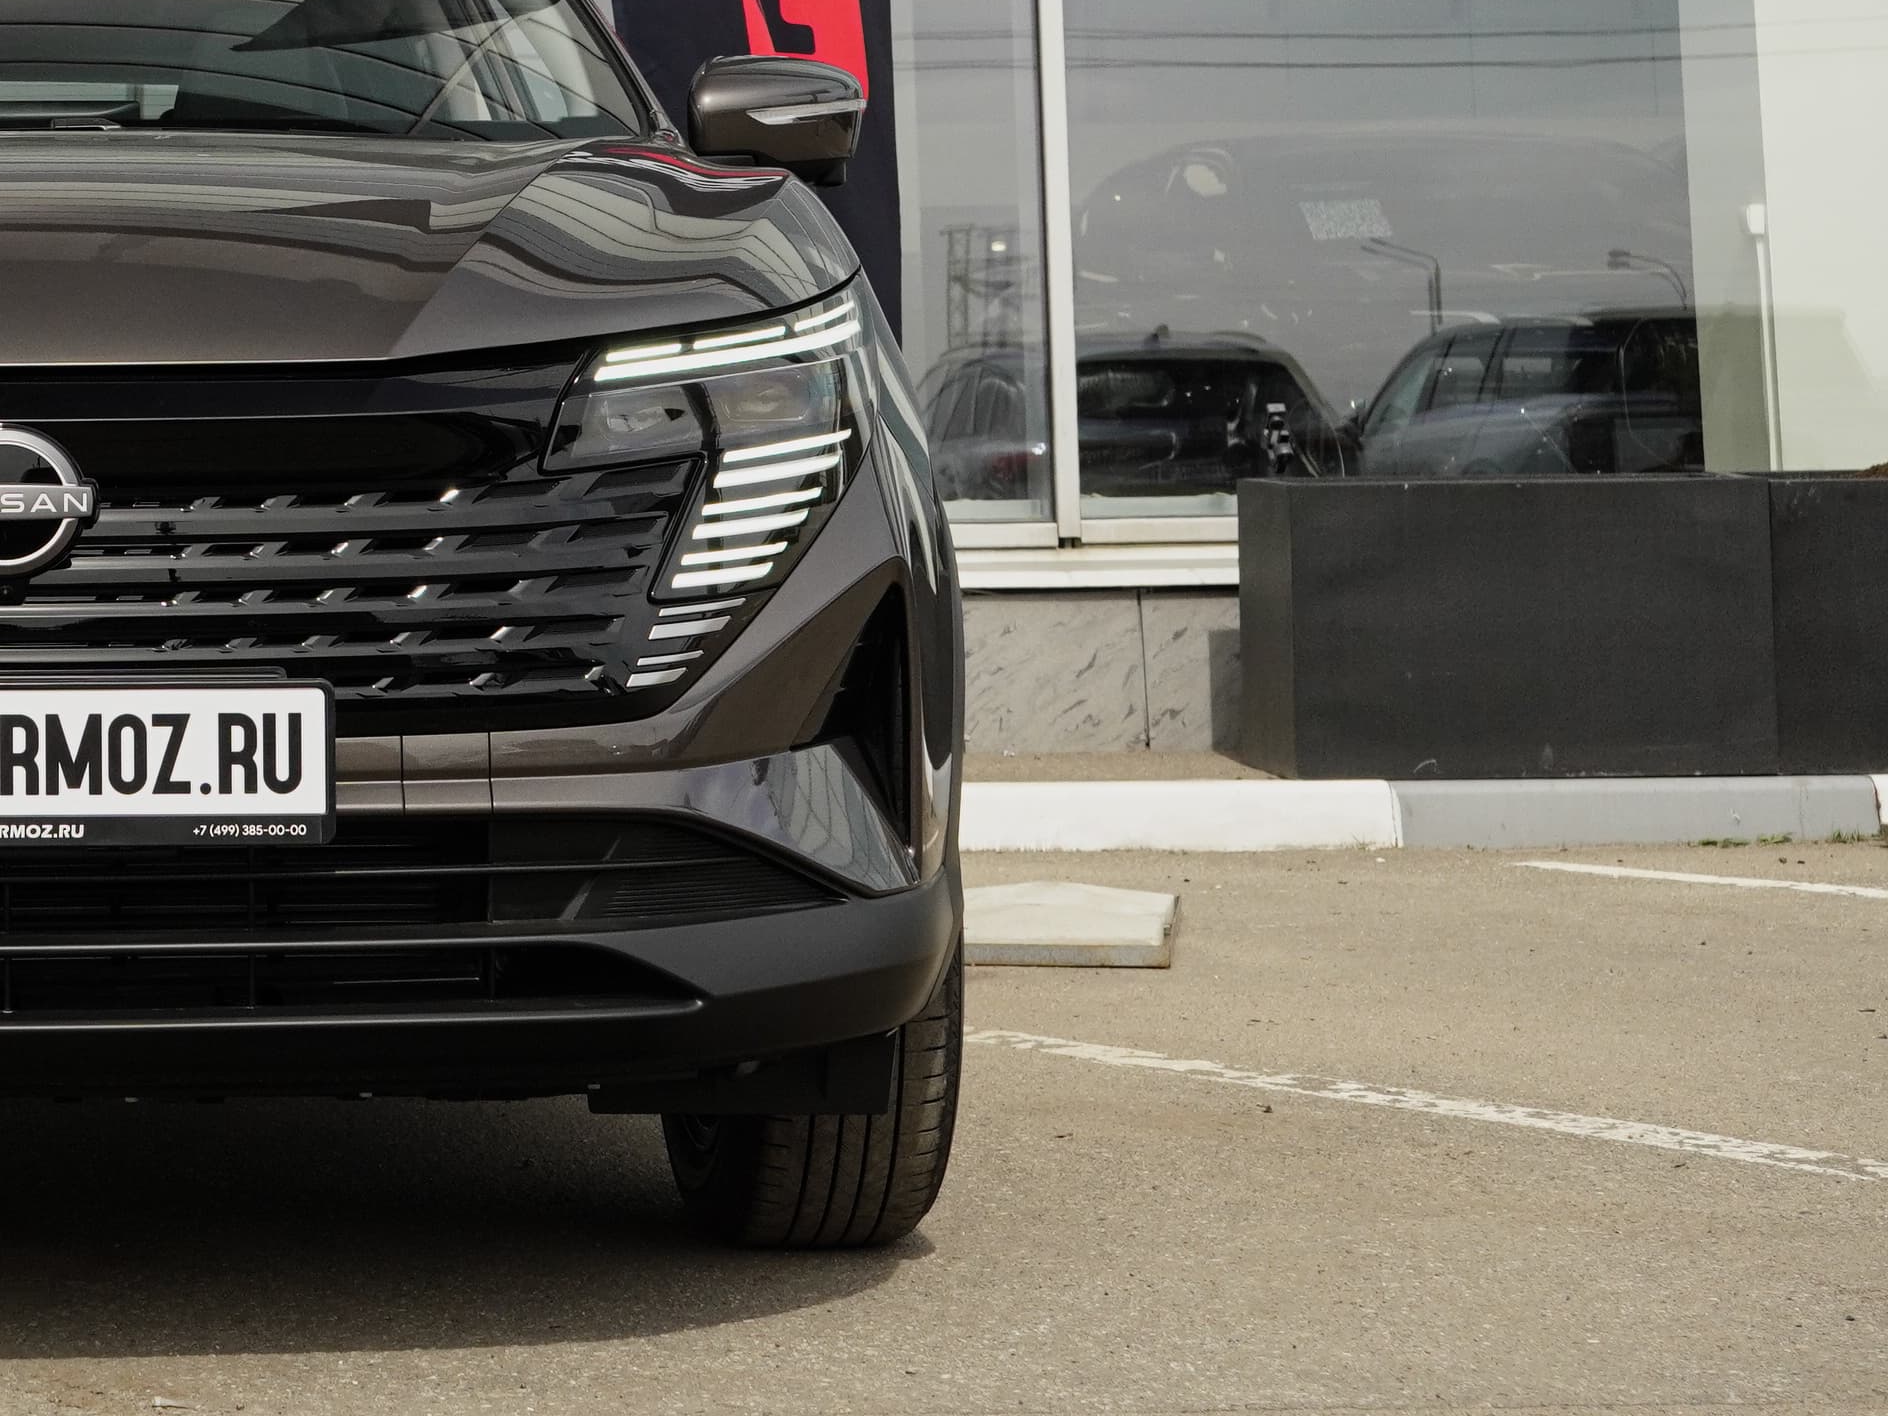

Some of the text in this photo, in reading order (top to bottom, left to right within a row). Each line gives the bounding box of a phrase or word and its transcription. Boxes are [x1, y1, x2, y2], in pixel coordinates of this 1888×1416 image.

[192, 823, 308, 838] +7 (499) 385-00-00
